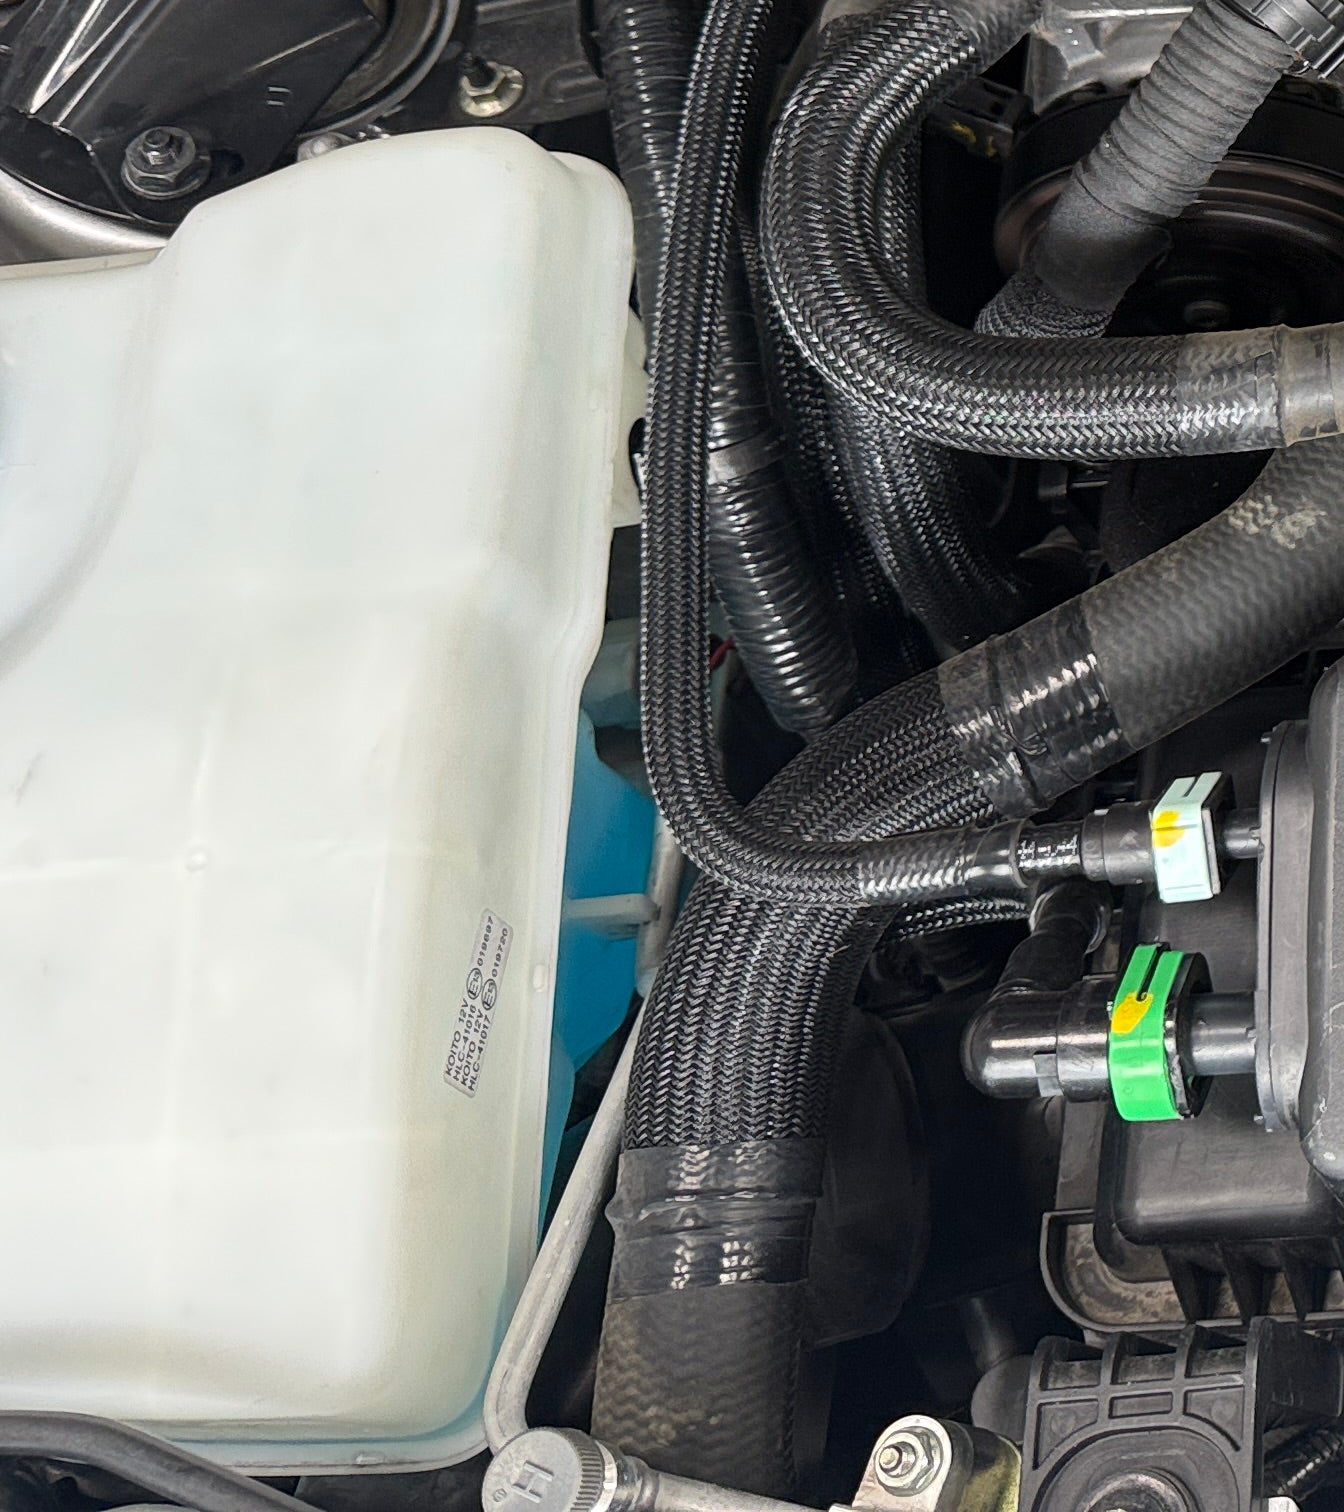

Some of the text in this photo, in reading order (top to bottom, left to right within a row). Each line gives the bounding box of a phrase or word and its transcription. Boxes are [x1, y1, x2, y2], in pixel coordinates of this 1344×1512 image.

[445, 998, 468, 1075] KOITO 12V
[460, 1008, 483, 1085] KOITO 12V
[468, 1015, 489, 1090] HLC-41017
[511, 1460, 556, 1504] H
